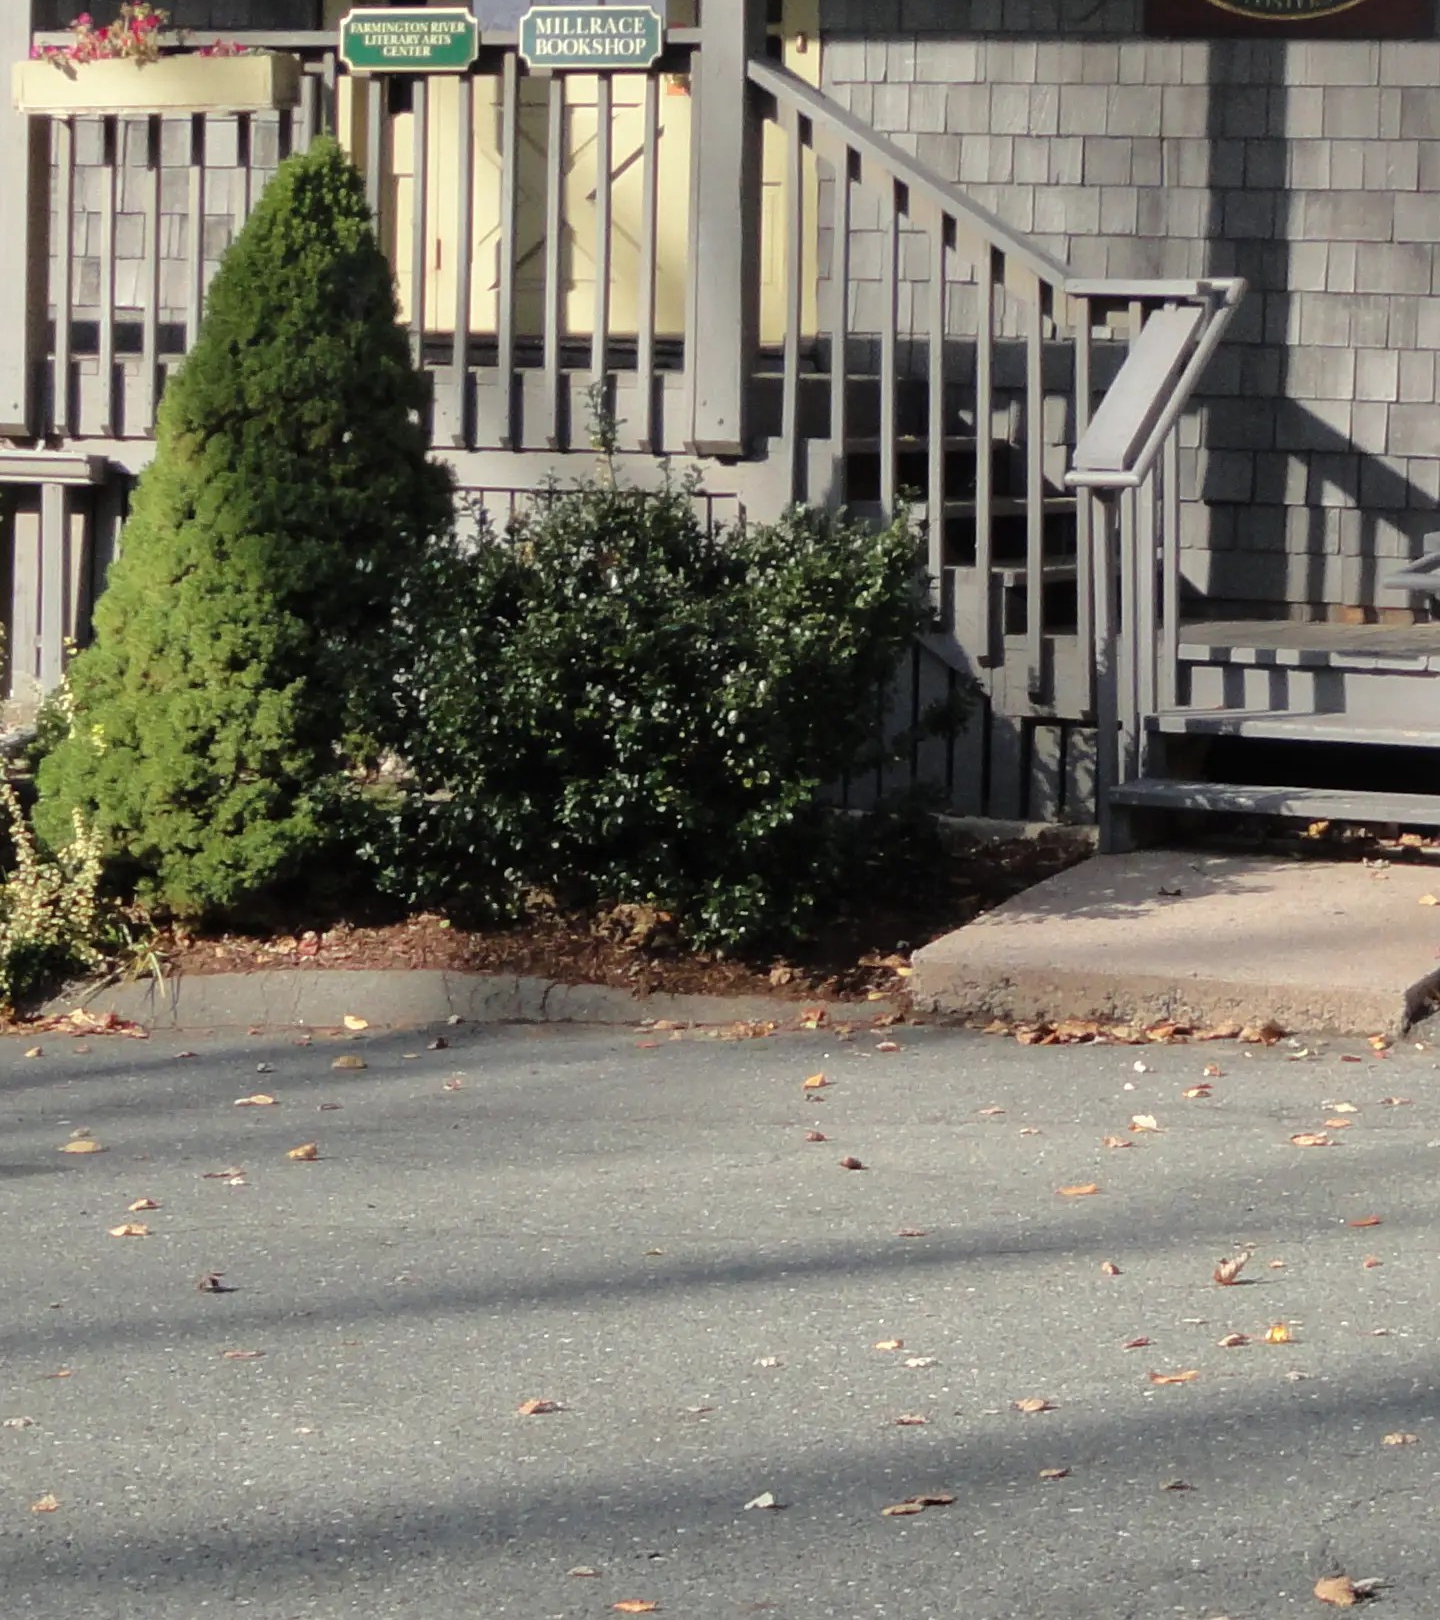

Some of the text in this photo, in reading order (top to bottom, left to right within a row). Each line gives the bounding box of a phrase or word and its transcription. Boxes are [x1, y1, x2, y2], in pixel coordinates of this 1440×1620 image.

[350, 21, 465, 33] FARMINGTON RIVER
[535, 16, 647, 35] MILLRACE
[364, 34, 451, 46] LITERARY ARTS
[382, 46, 432, 56] CENTER
[535, 37, 647, 56] BOOKSHOP
